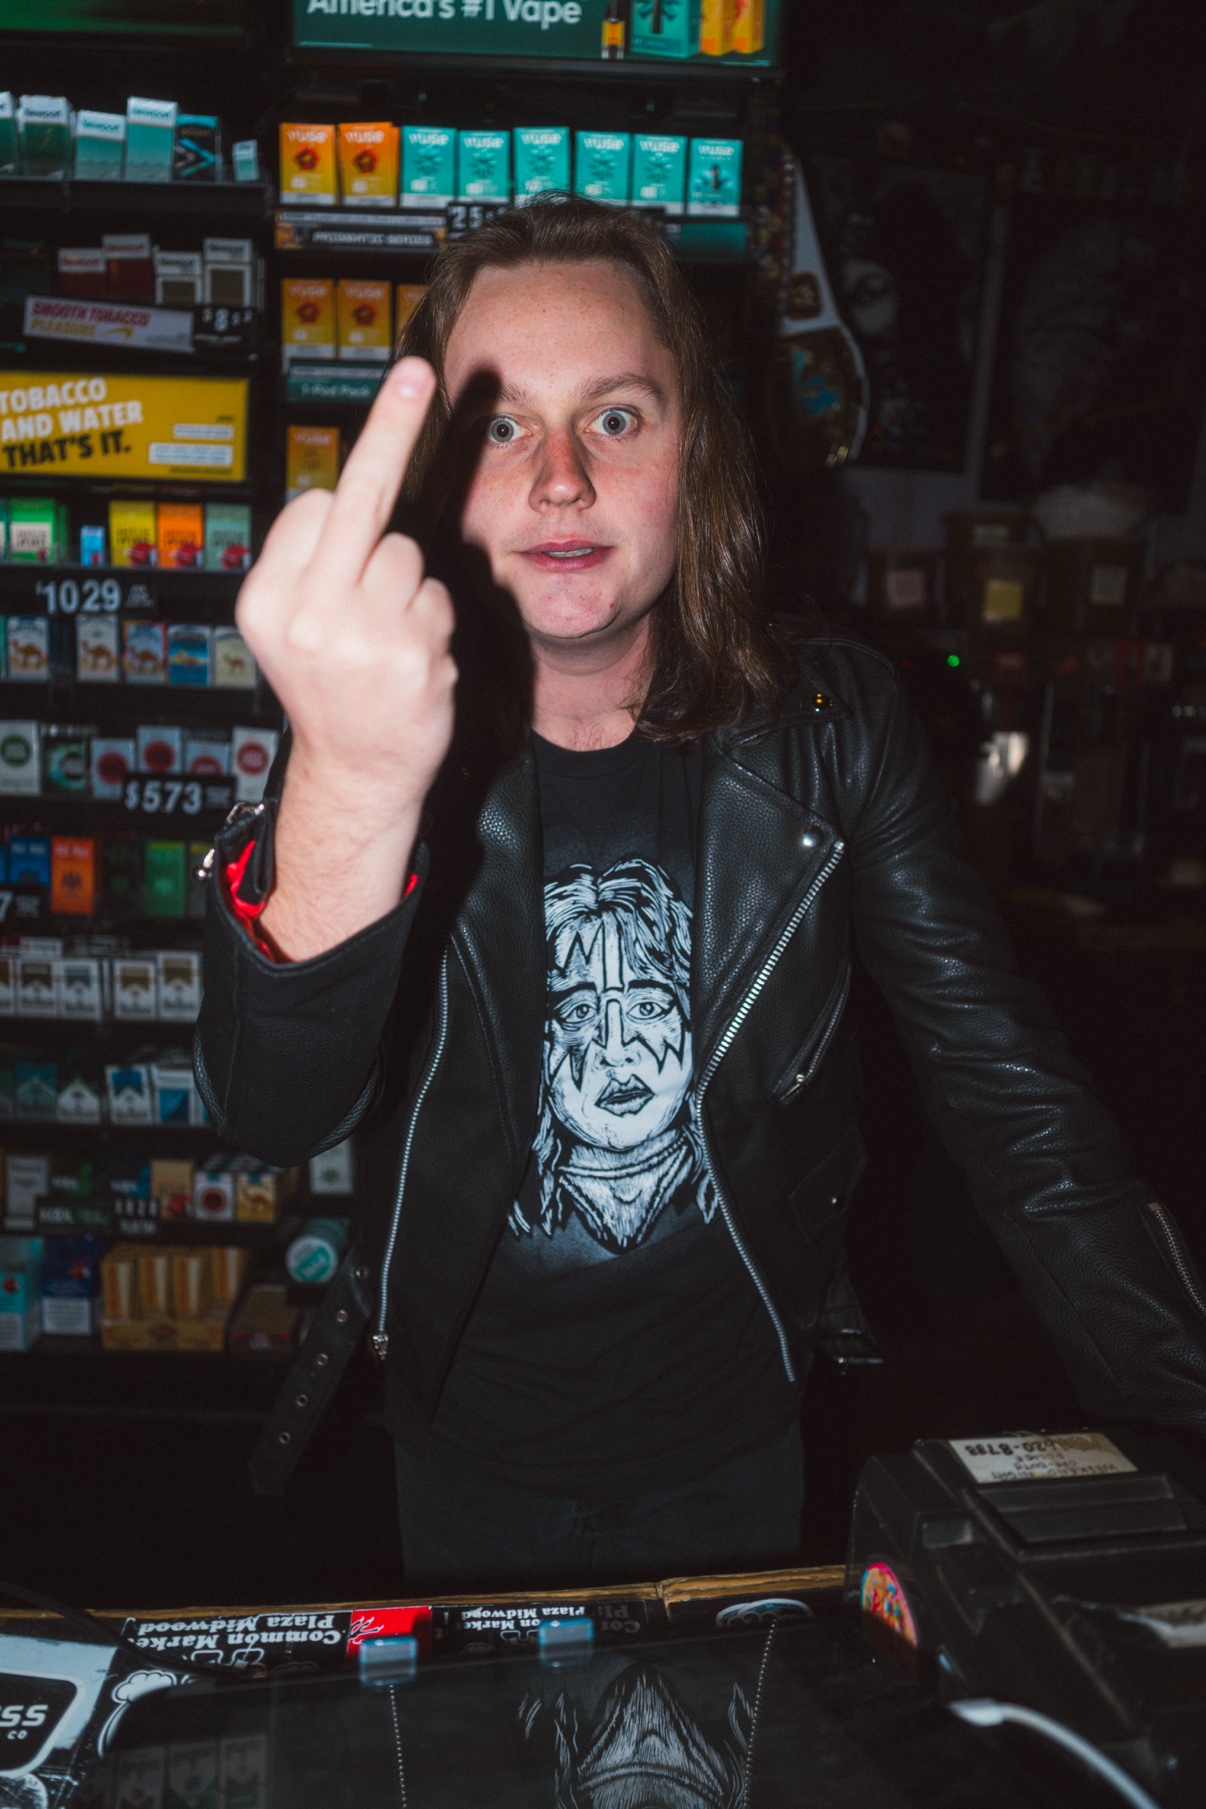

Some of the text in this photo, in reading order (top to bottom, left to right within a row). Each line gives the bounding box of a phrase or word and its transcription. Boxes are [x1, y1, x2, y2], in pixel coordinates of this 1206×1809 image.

[504, 0, 583, 30] Vape
[32, 302, 151, 327] SMOOTH TOBACCO
[30, 317, 97, 337] PLEASURE
[0, 377, 107, 415] TOBACCO
[1, 400, 145, 443] AND WATER
[3, 434, 95, 470] THAT'S
[101, 430, 132, 456] IT.
[124, 779, 203, 816] $573
[541, 1606, 586, 1617] Plaza
[137, 1614, 336, 1636] Plaza Midwood
[228, 1630, 342, 1646] Common
[0, 1704, 49, 1728] SS
[7, 1730, 28, 1740] CO
